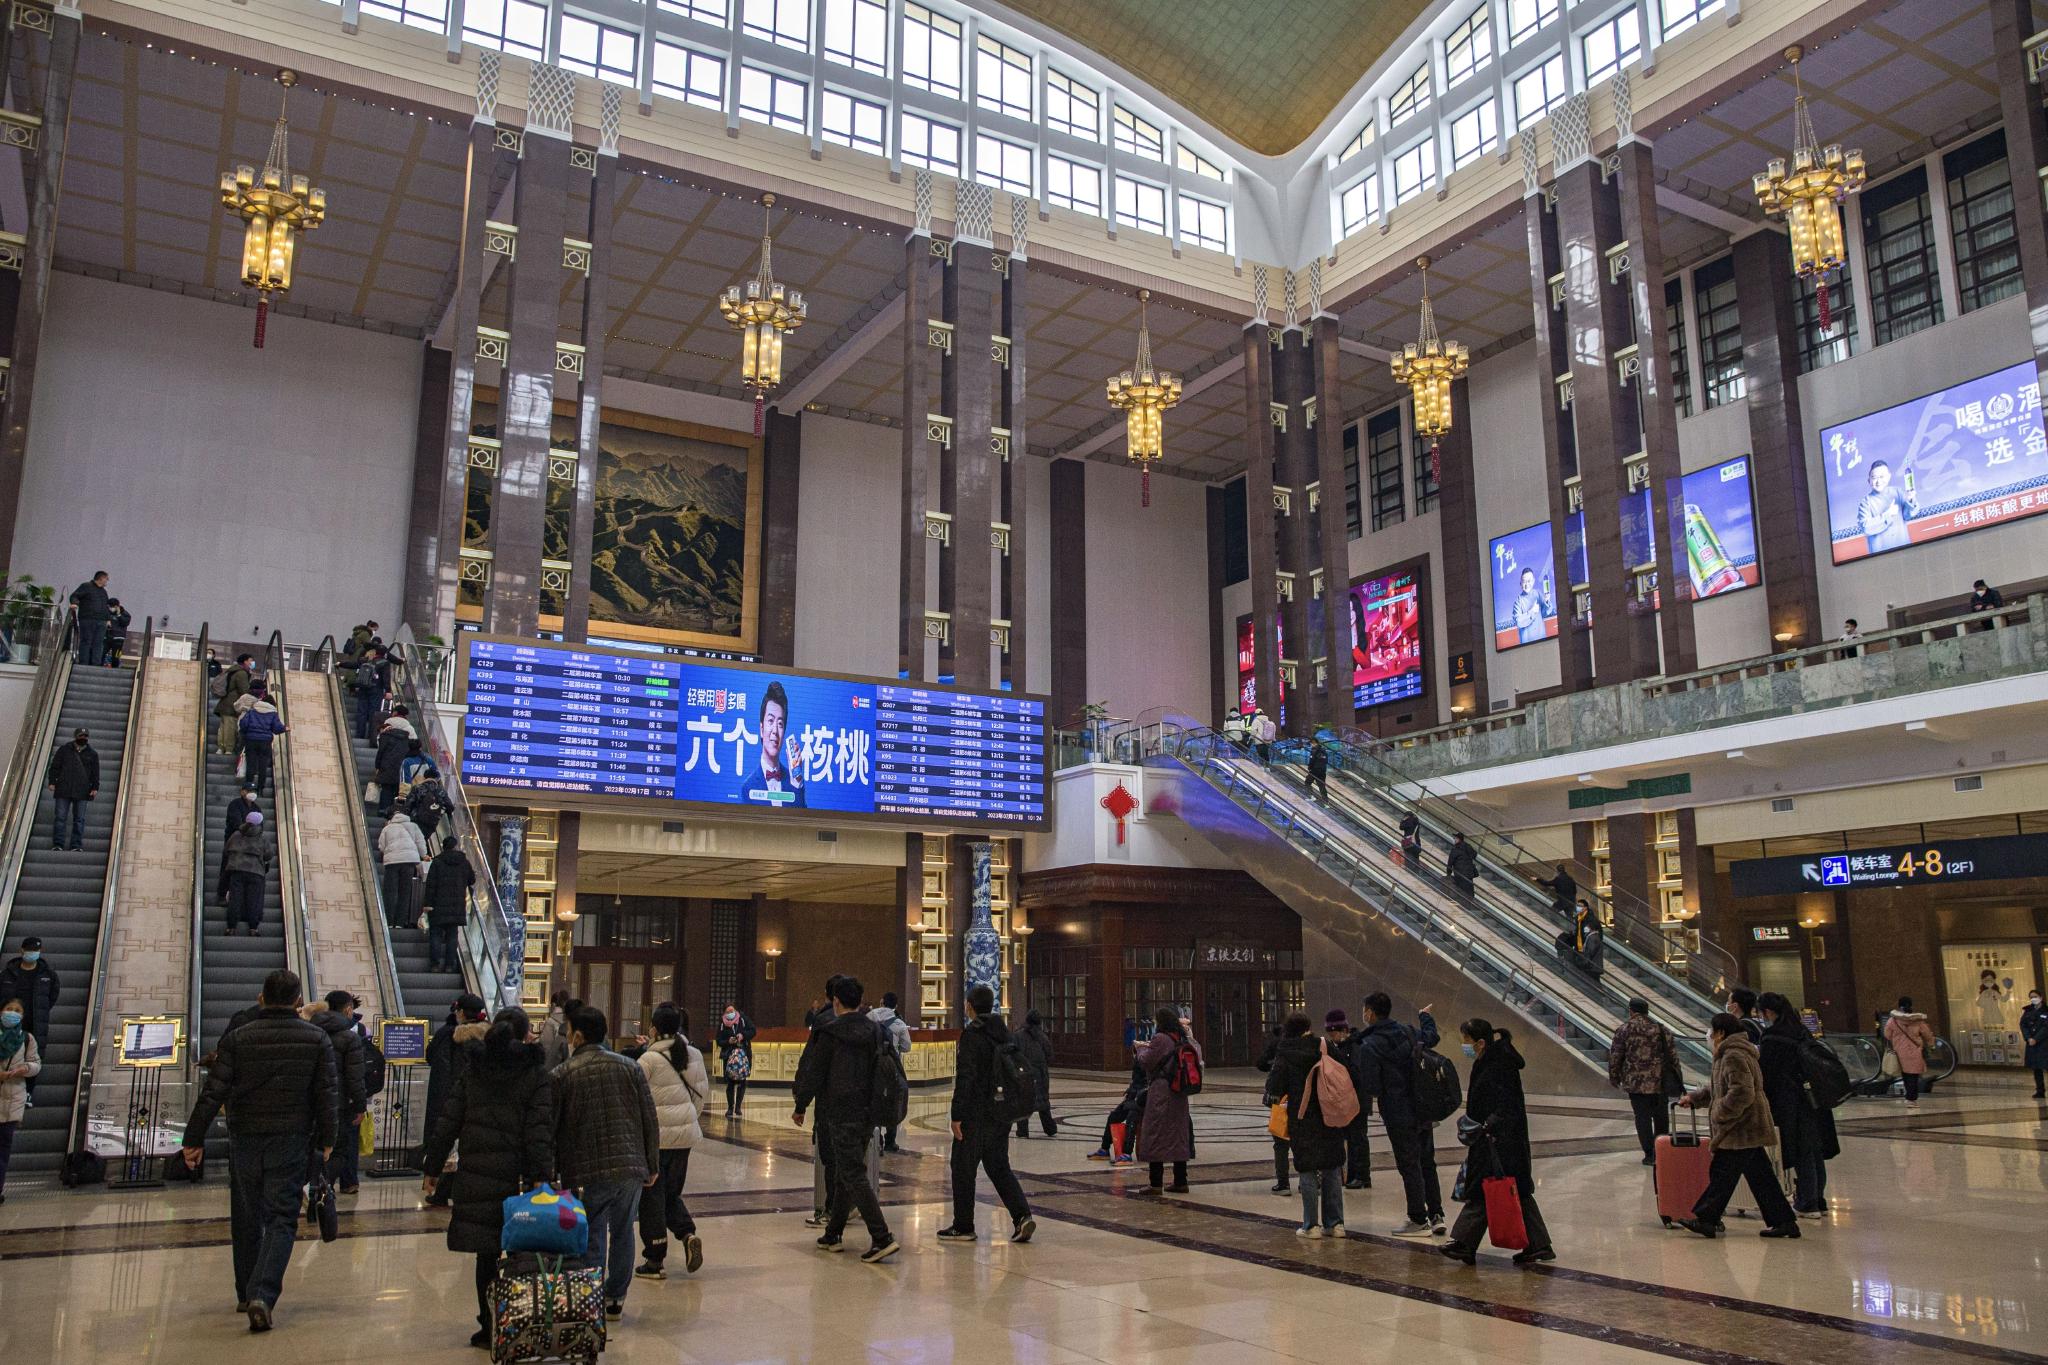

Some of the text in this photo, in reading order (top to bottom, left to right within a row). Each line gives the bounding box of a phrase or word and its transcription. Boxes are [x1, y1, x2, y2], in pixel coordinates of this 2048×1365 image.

[1956, 401, 1984, 429] 喝
[2017, 383, 2042, 412] 酒
[1985, 437, 2014, 468] 选
[1457, 655, 1464, 669] 6
[685, 715, 869, 785] 六个 核桃
[605, 786, 649, 795] 2023年02月17日
[1850, 849, 1974, 877] 候车室 4-8 (2F)
[1852, 871, 1899, 881] Waiting Lounge
